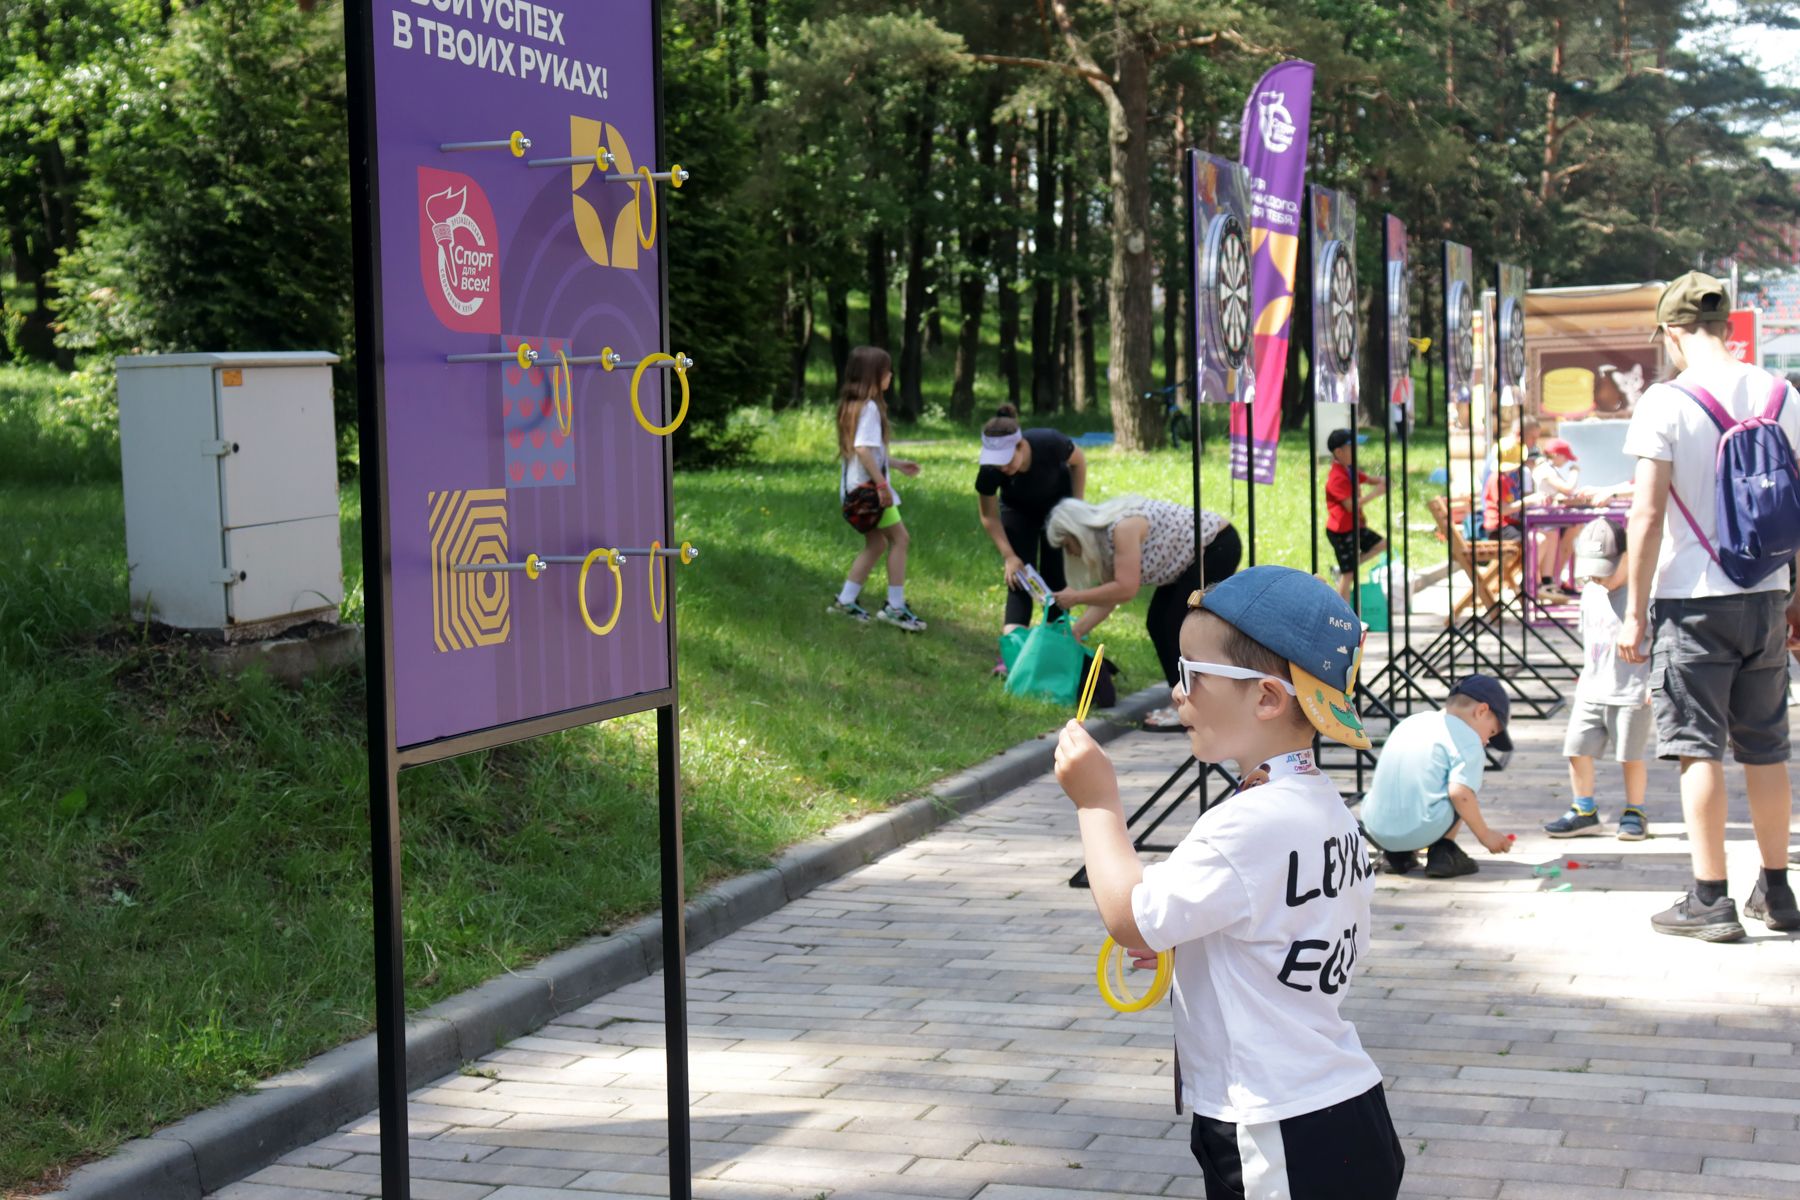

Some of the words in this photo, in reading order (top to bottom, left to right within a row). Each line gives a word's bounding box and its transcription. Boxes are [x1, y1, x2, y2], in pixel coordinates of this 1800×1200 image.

[479, 0, 566, 46] УСПЕХ
[392, 9, 414, 50] В
[417, 16, 517, 77] ТВОИХ
[520, 45, 608, 100] РУКАХ!
[455, 246, 494, 271] Спорт
[462, 266, 477, 276] для
[461, 275, 491, 292] всех!
[1329, 616, 1353, 631] RACER
